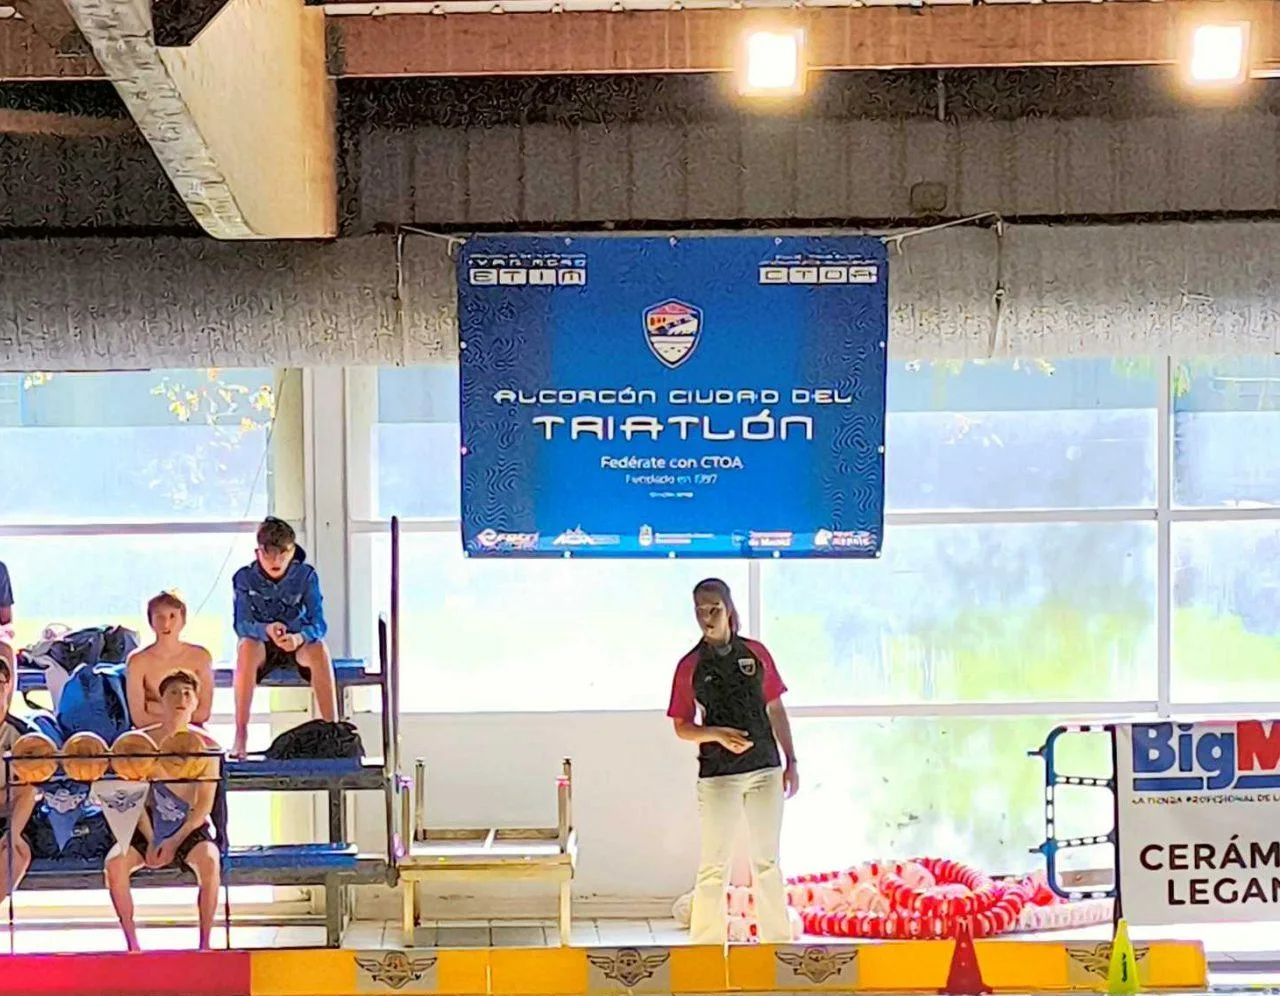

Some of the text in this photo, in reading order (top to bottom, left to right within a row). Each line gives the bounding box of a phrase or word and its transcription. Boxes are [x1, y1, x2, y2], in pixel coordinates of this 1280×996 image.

[759, 267, 877, 284] CTOA
[493, 386, 852, 405] ALCORCÓN CIUDAD DEL
[531, 408, 813, 441] TRIATLÓN
[600, 455, 744, 469] Fedérate con CTOA
